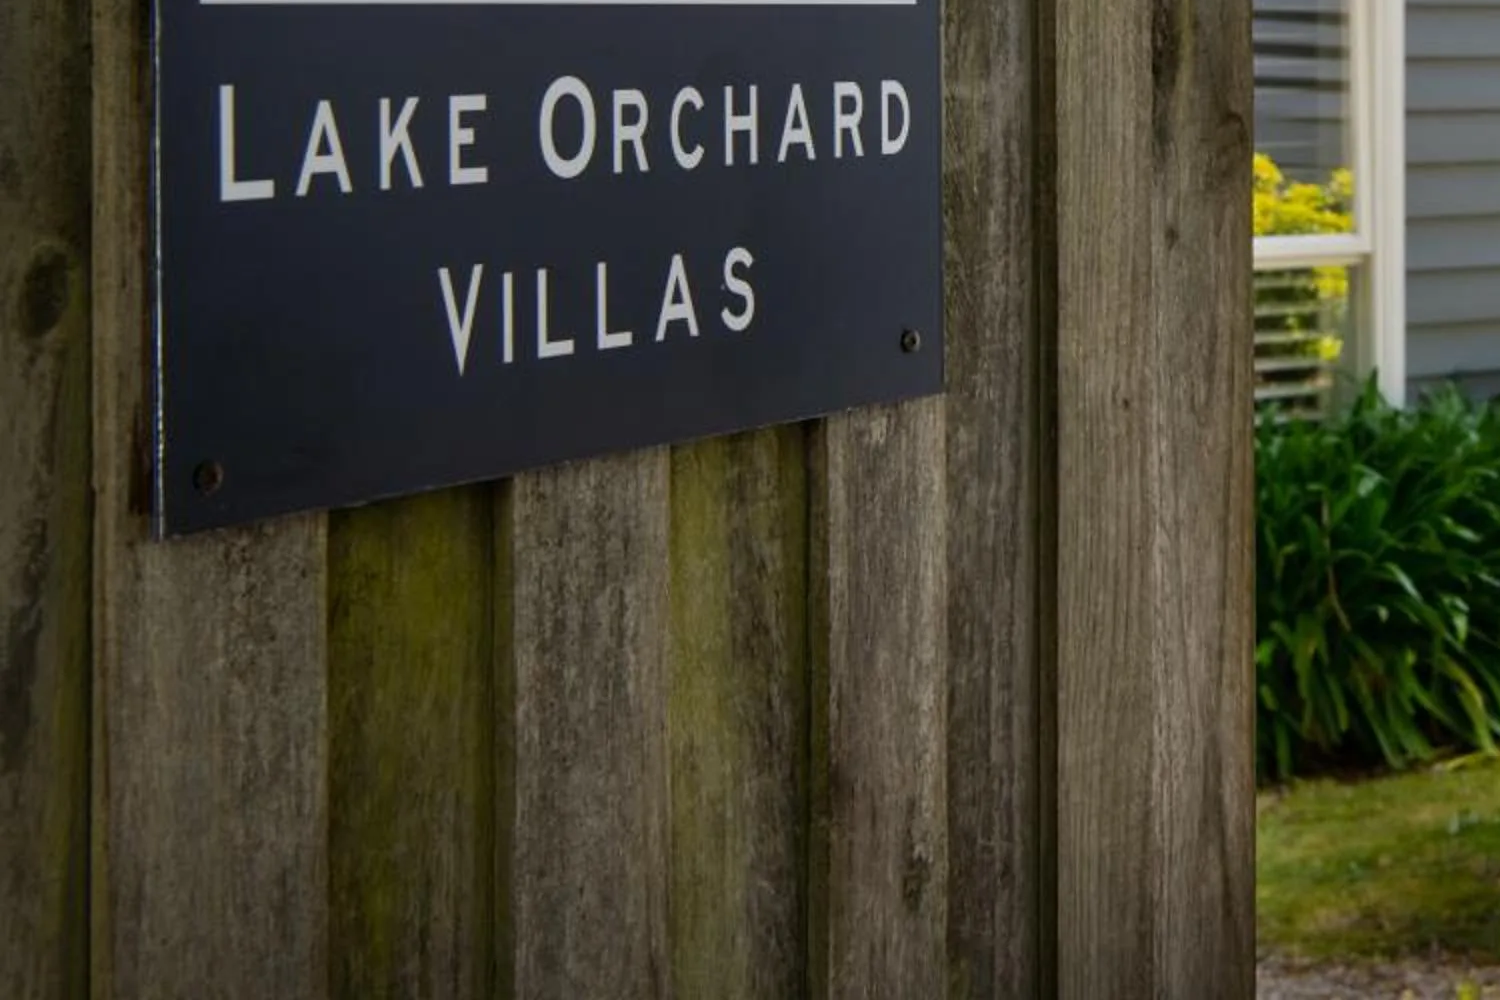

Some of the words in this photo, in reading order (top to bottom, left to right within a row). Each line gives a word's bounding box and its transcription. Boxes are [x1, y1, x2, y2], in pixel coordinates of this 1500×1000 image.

[219, 84, 490, 203] LAKE
[538, 74, 912, 179] ORCHARD
[438, 246, 756, 376] VILLAS
